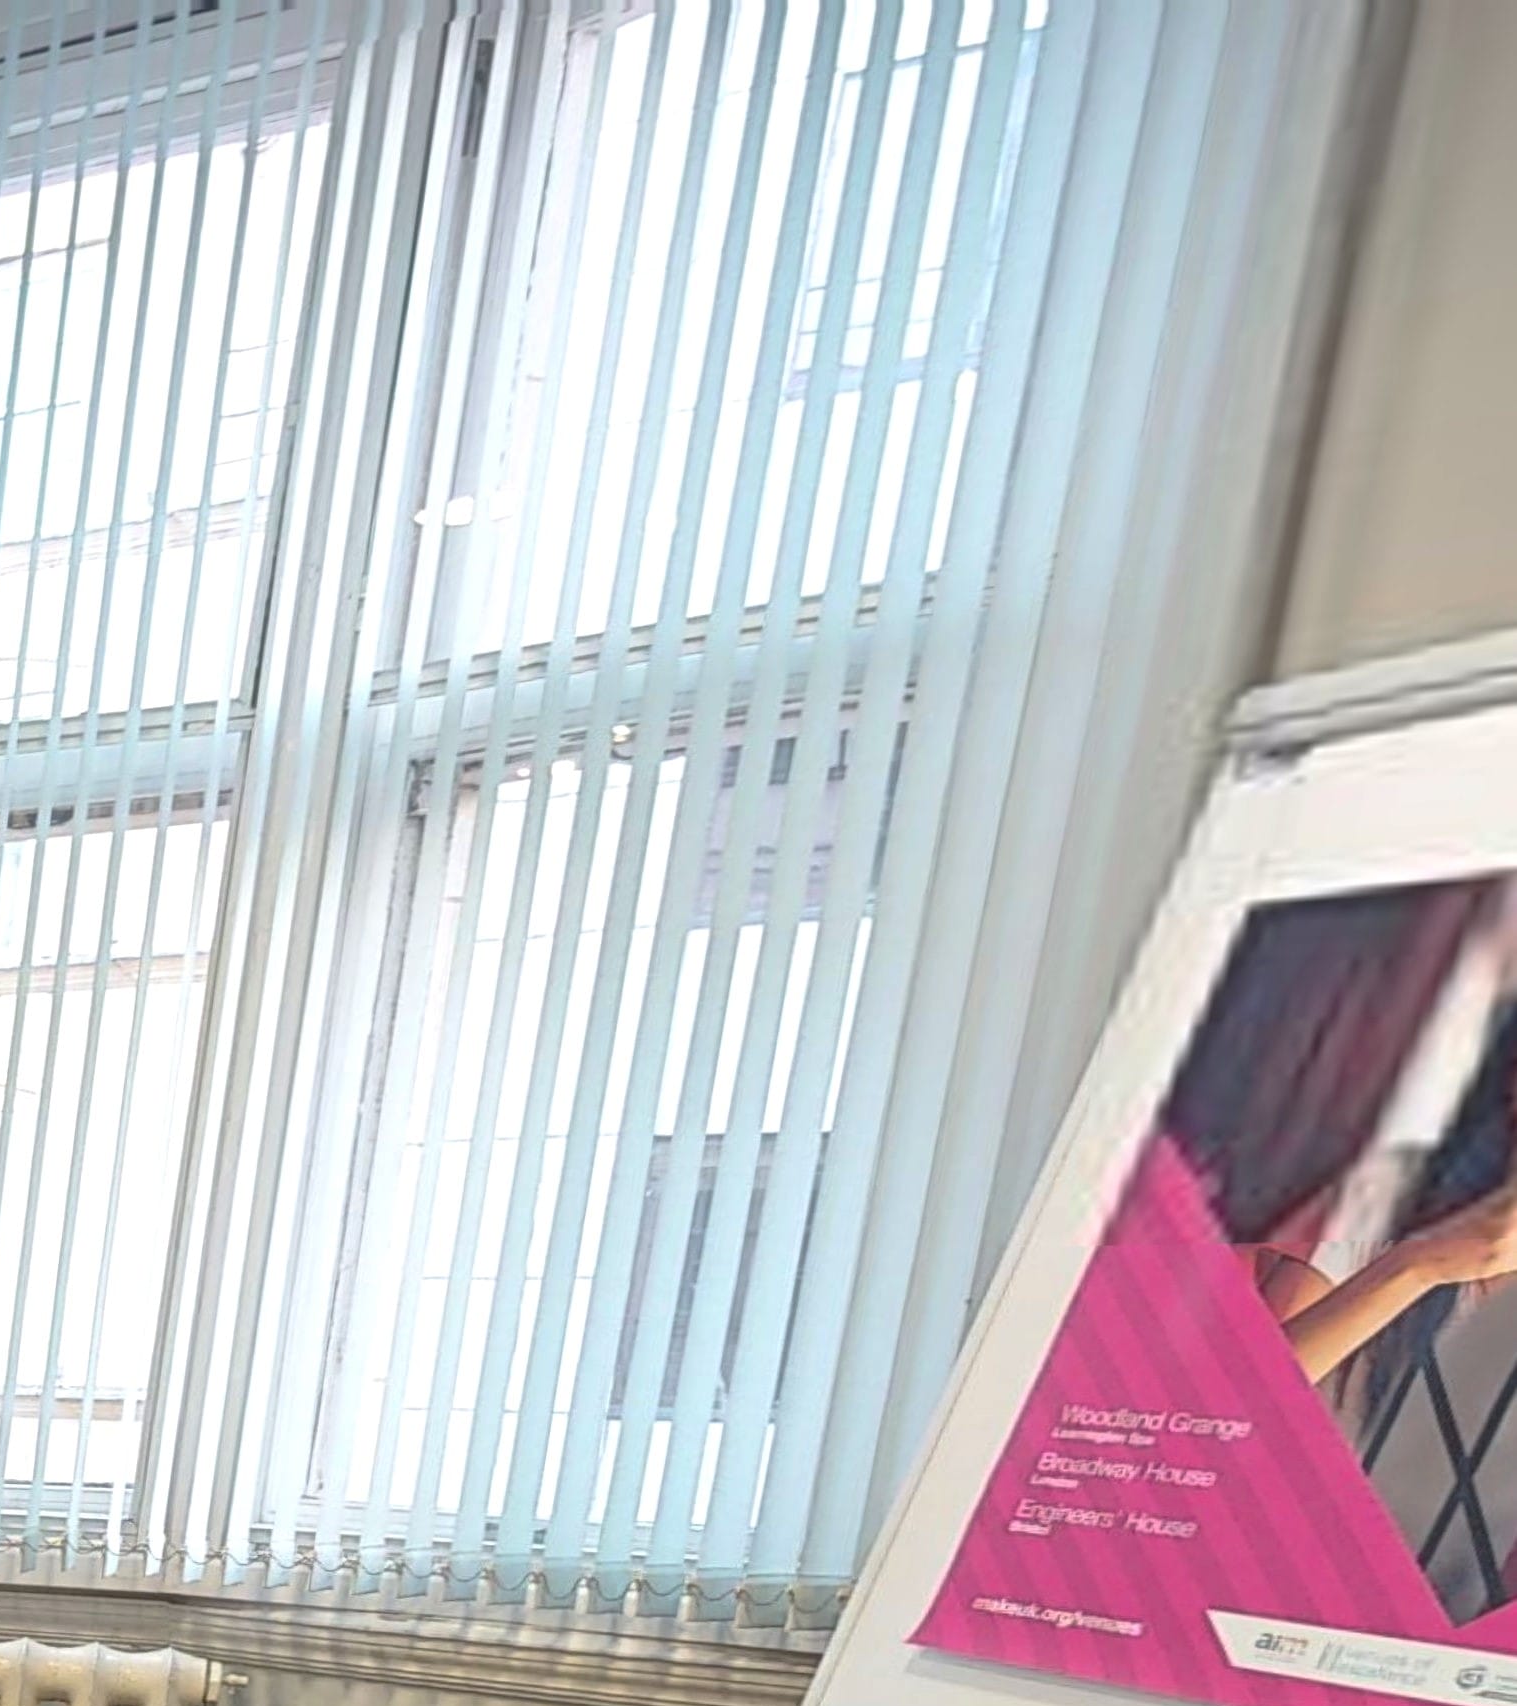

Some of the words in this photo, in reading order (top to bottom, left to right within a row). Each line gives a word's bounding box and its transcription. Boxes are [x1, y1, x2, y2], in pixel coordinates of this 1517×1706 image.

[1060, 1404, 1167, 1431] Woodland
[1168, 1412, 1254, 1440] Grange
[1037, 1451, 1139, 1480] Broadway
[1143, 1461, 1218, 1488] House
[1124, 1511, 1198, 1539] House
